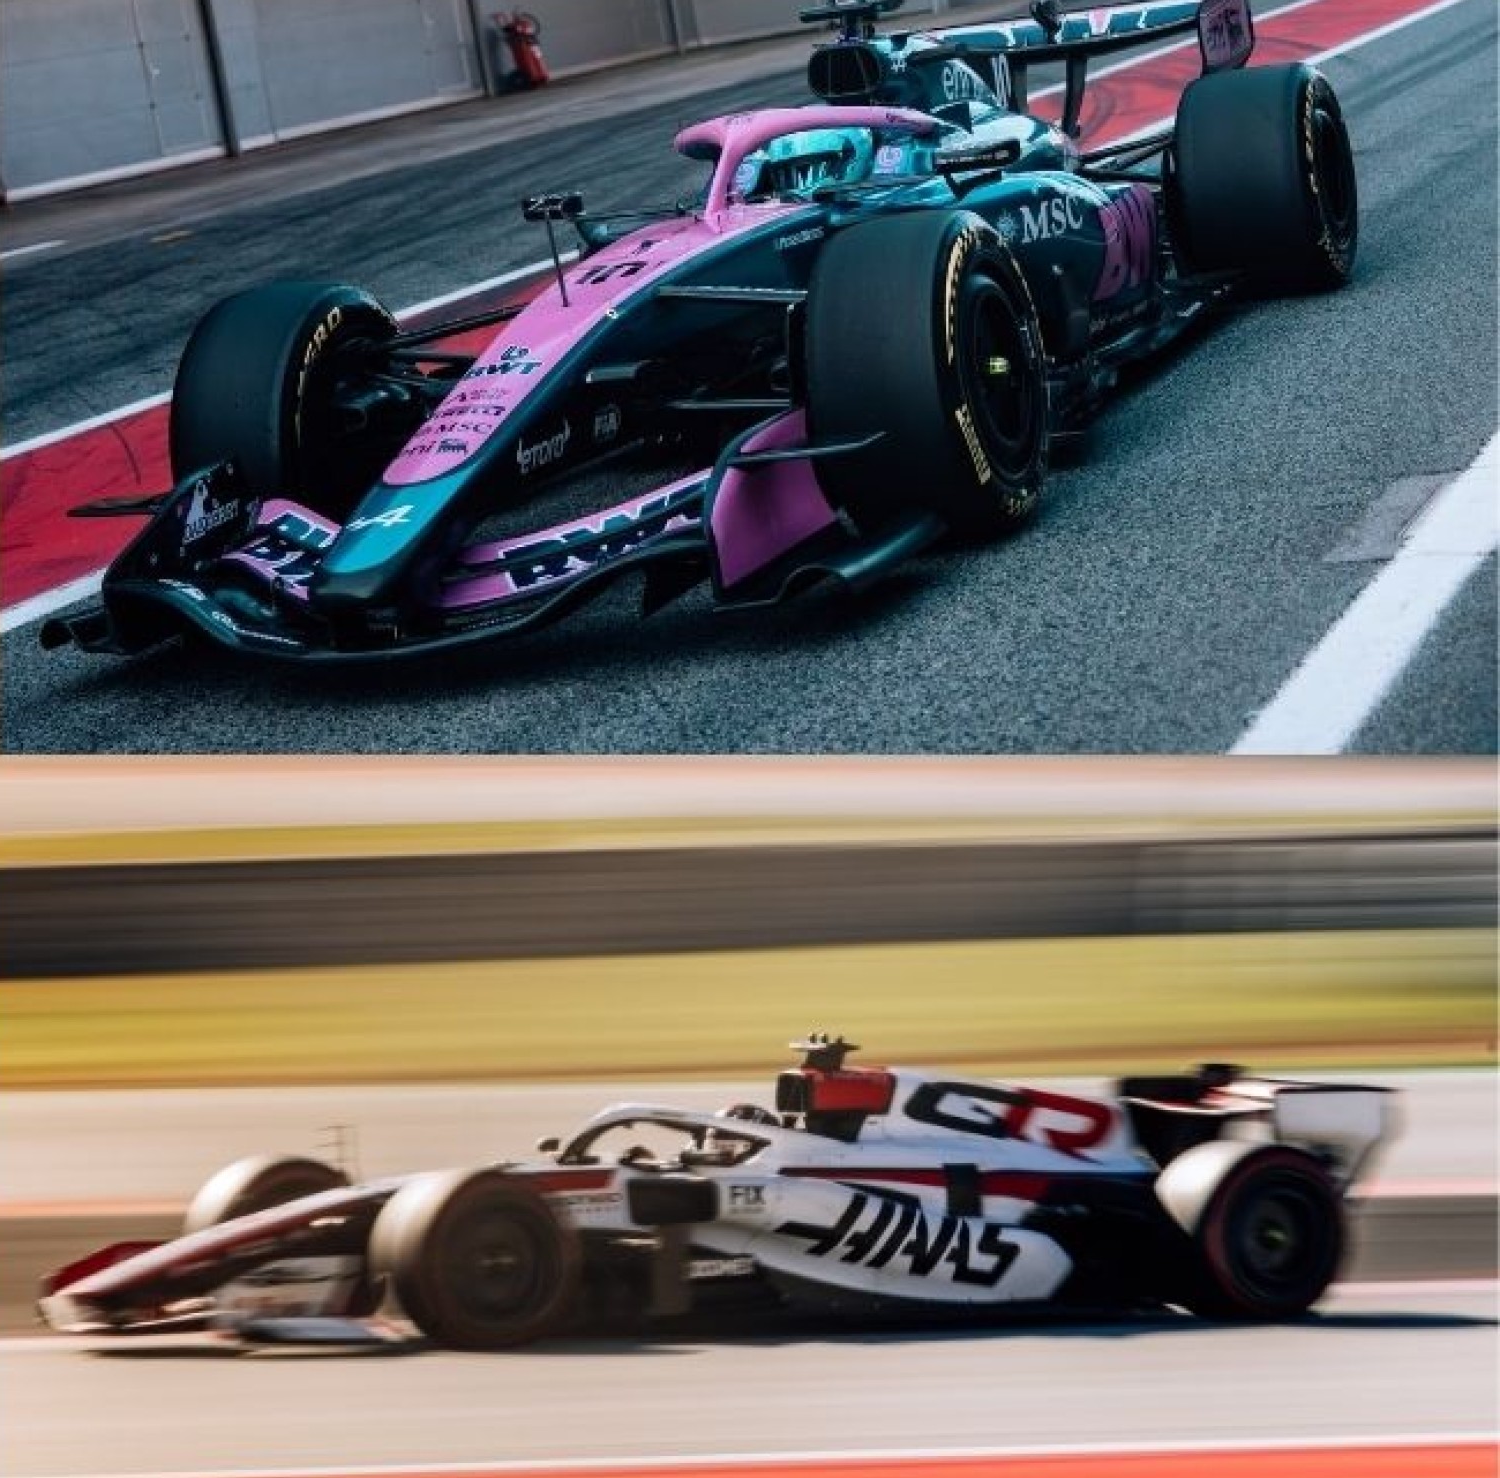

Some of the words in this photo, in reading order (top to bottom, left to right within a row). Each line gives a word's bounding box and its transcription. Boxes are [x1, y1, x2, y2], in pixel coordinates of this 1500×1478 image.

[1019, 196, 1084, 245] MSC
[729, 1185, 766, 1205] FIX
[772, 1180, 1021, 1287] HAAS
